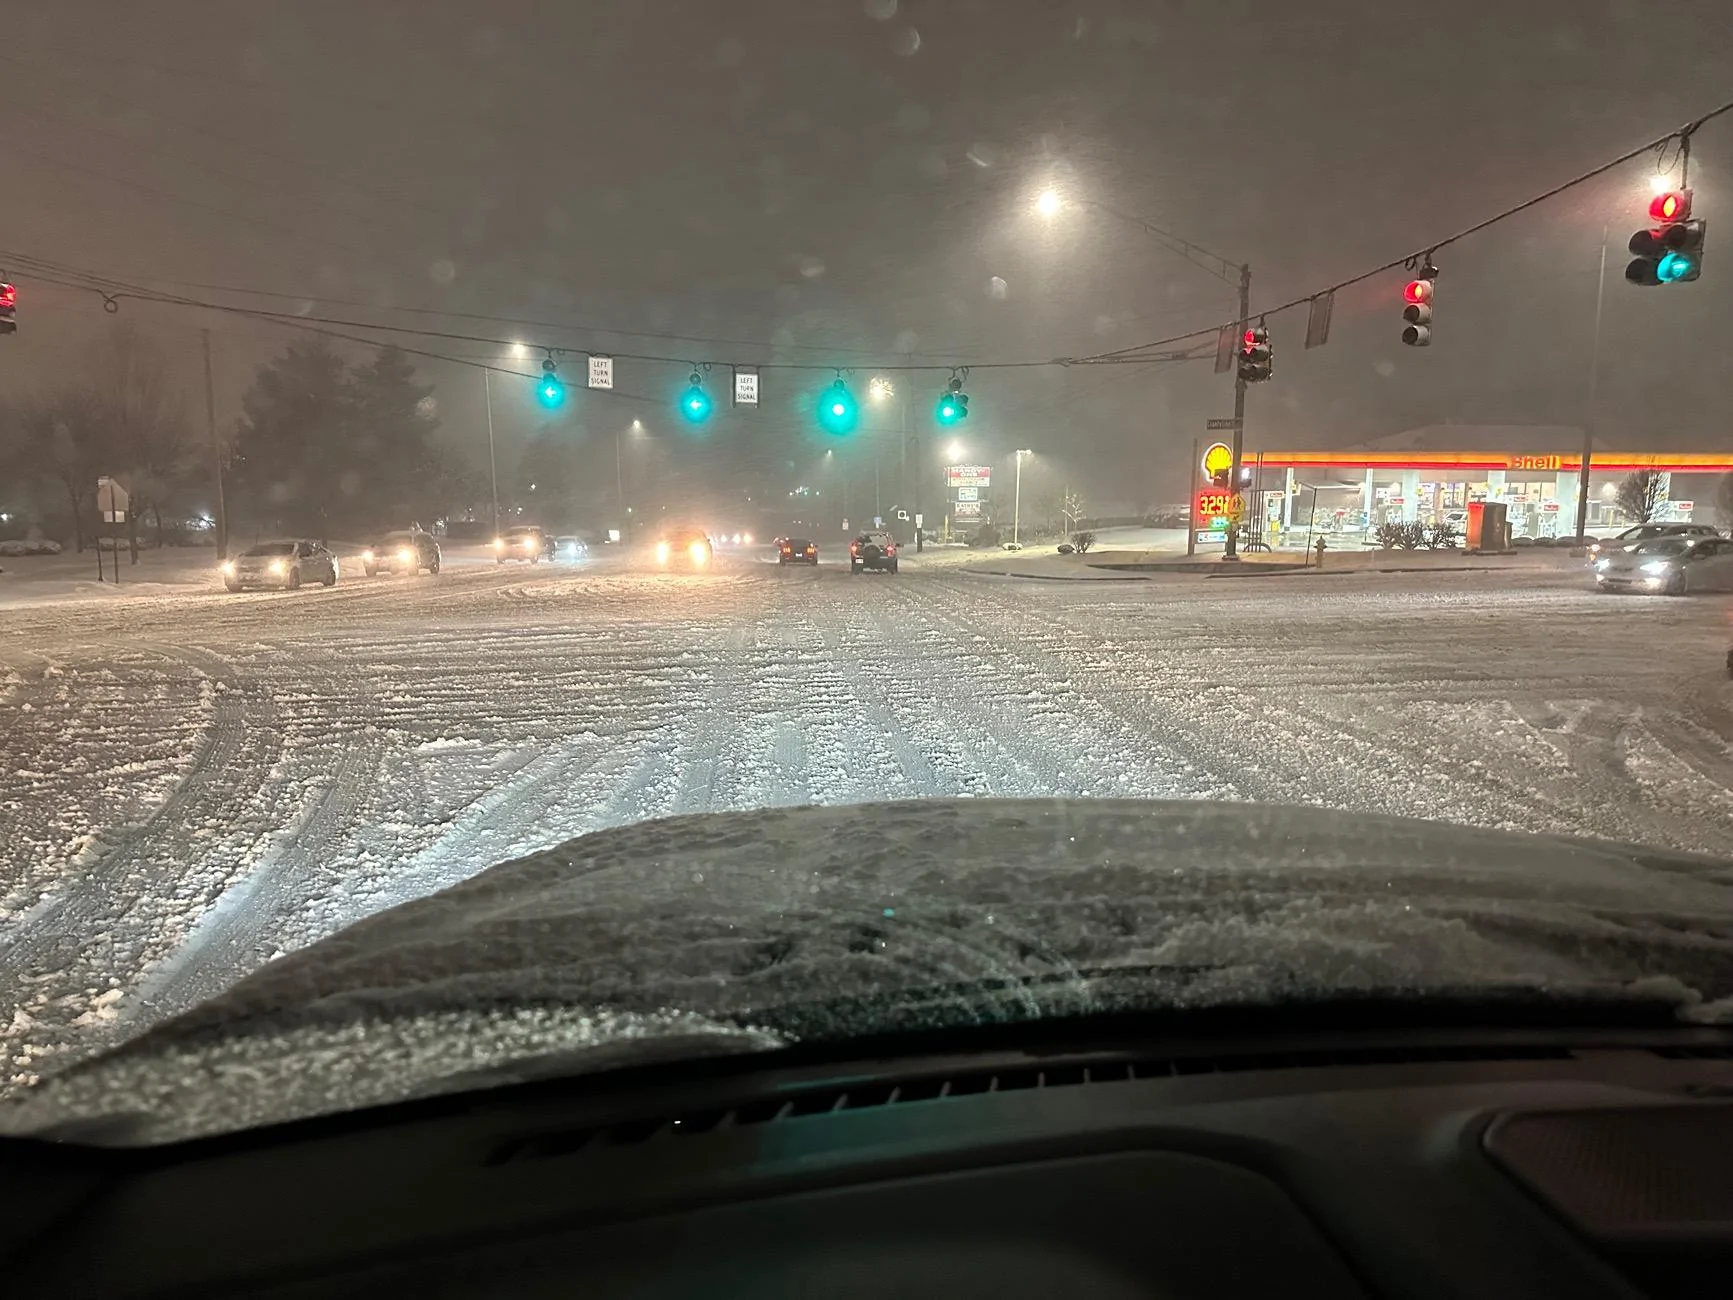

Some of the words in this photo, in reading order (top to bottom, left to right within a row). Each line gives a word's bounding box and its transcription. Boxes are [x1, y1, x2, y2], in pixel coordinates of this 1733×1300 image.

[590, 377, 610, 386] SIGNAL
[737, 393, 756, 401] SIGNAL
[1511, 455, 1559, 469] Shell
